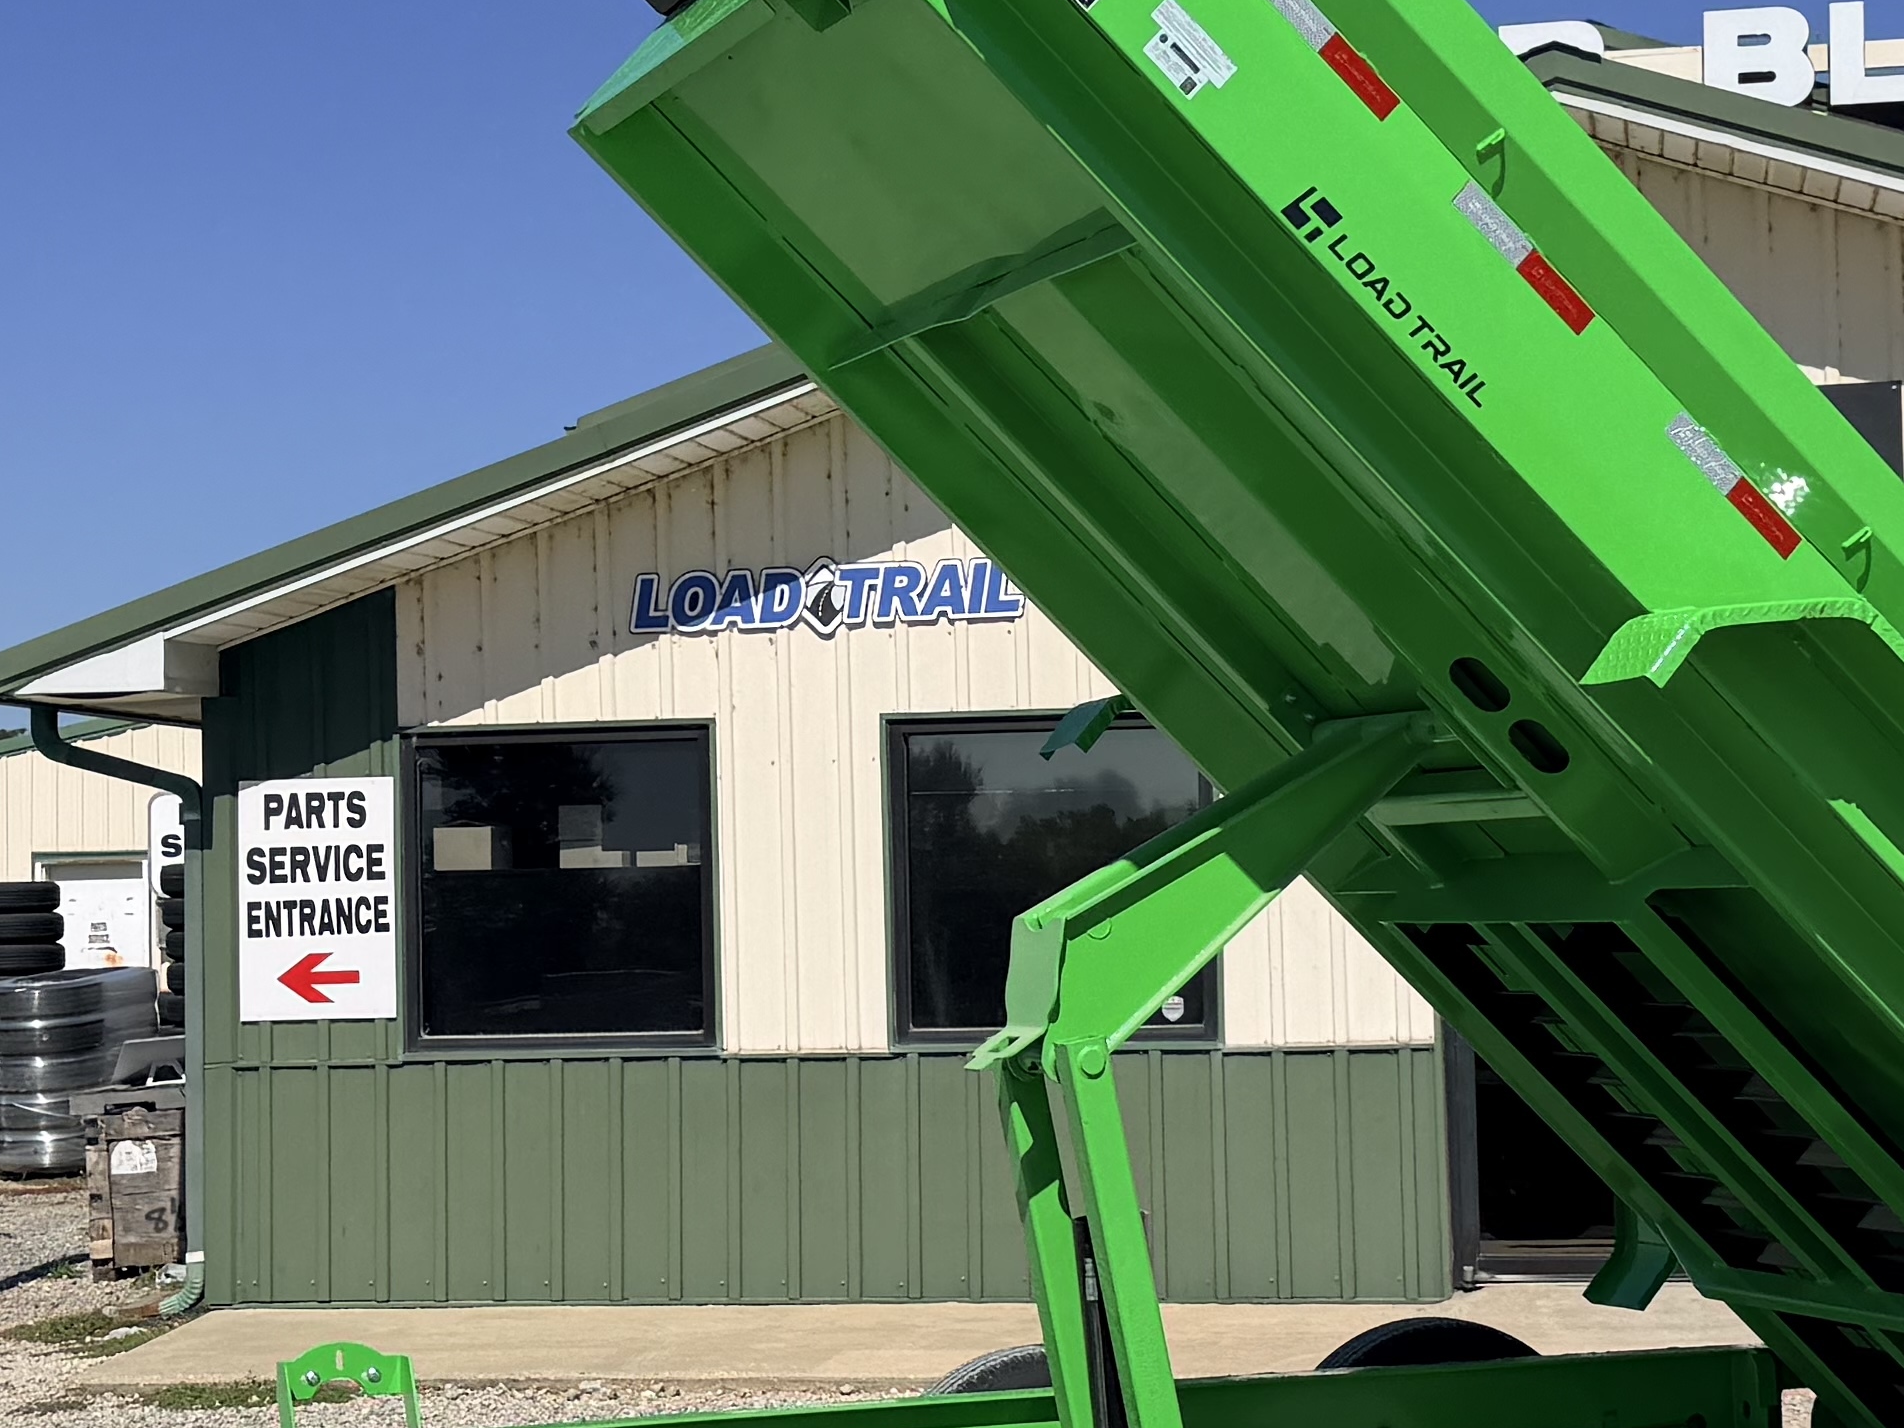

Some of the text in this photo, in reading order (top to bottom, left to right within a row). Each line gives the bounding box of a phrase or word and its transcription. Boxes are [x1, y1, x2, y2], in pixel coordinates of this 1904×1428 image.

[1326, 233, 1487, 409] LOAD TRAIL
[632, 558, 1023, 632] LOAD TRAIL
[262, 790, 368, 831] PARTS
[245, 843, 387, 885] SERVICE
[246, 895, 391, 939] ENTRANCE
